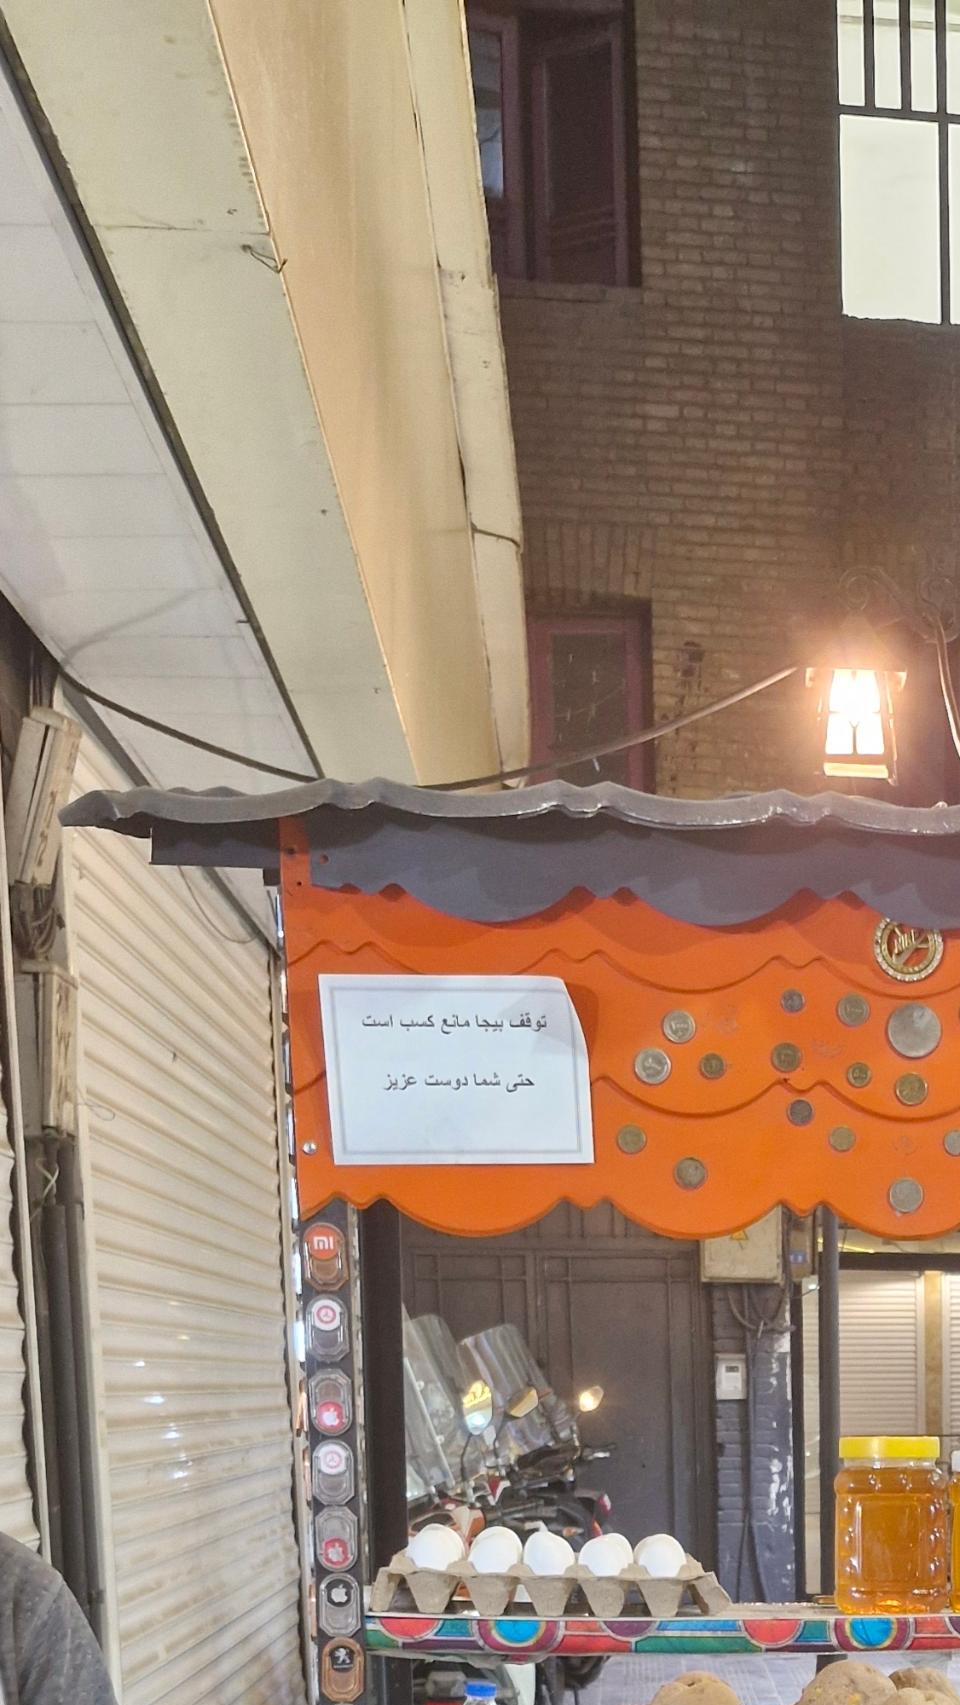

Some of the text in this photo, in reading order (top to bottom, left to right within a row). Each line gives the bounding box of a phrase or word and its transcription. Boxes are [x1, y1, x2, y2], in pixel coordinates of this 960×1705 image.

[362, 1012, 547, 1034] توقف بیجا مانع کسب است
[383, 1072, 535, 1093] حتی شما دوست عزیز
